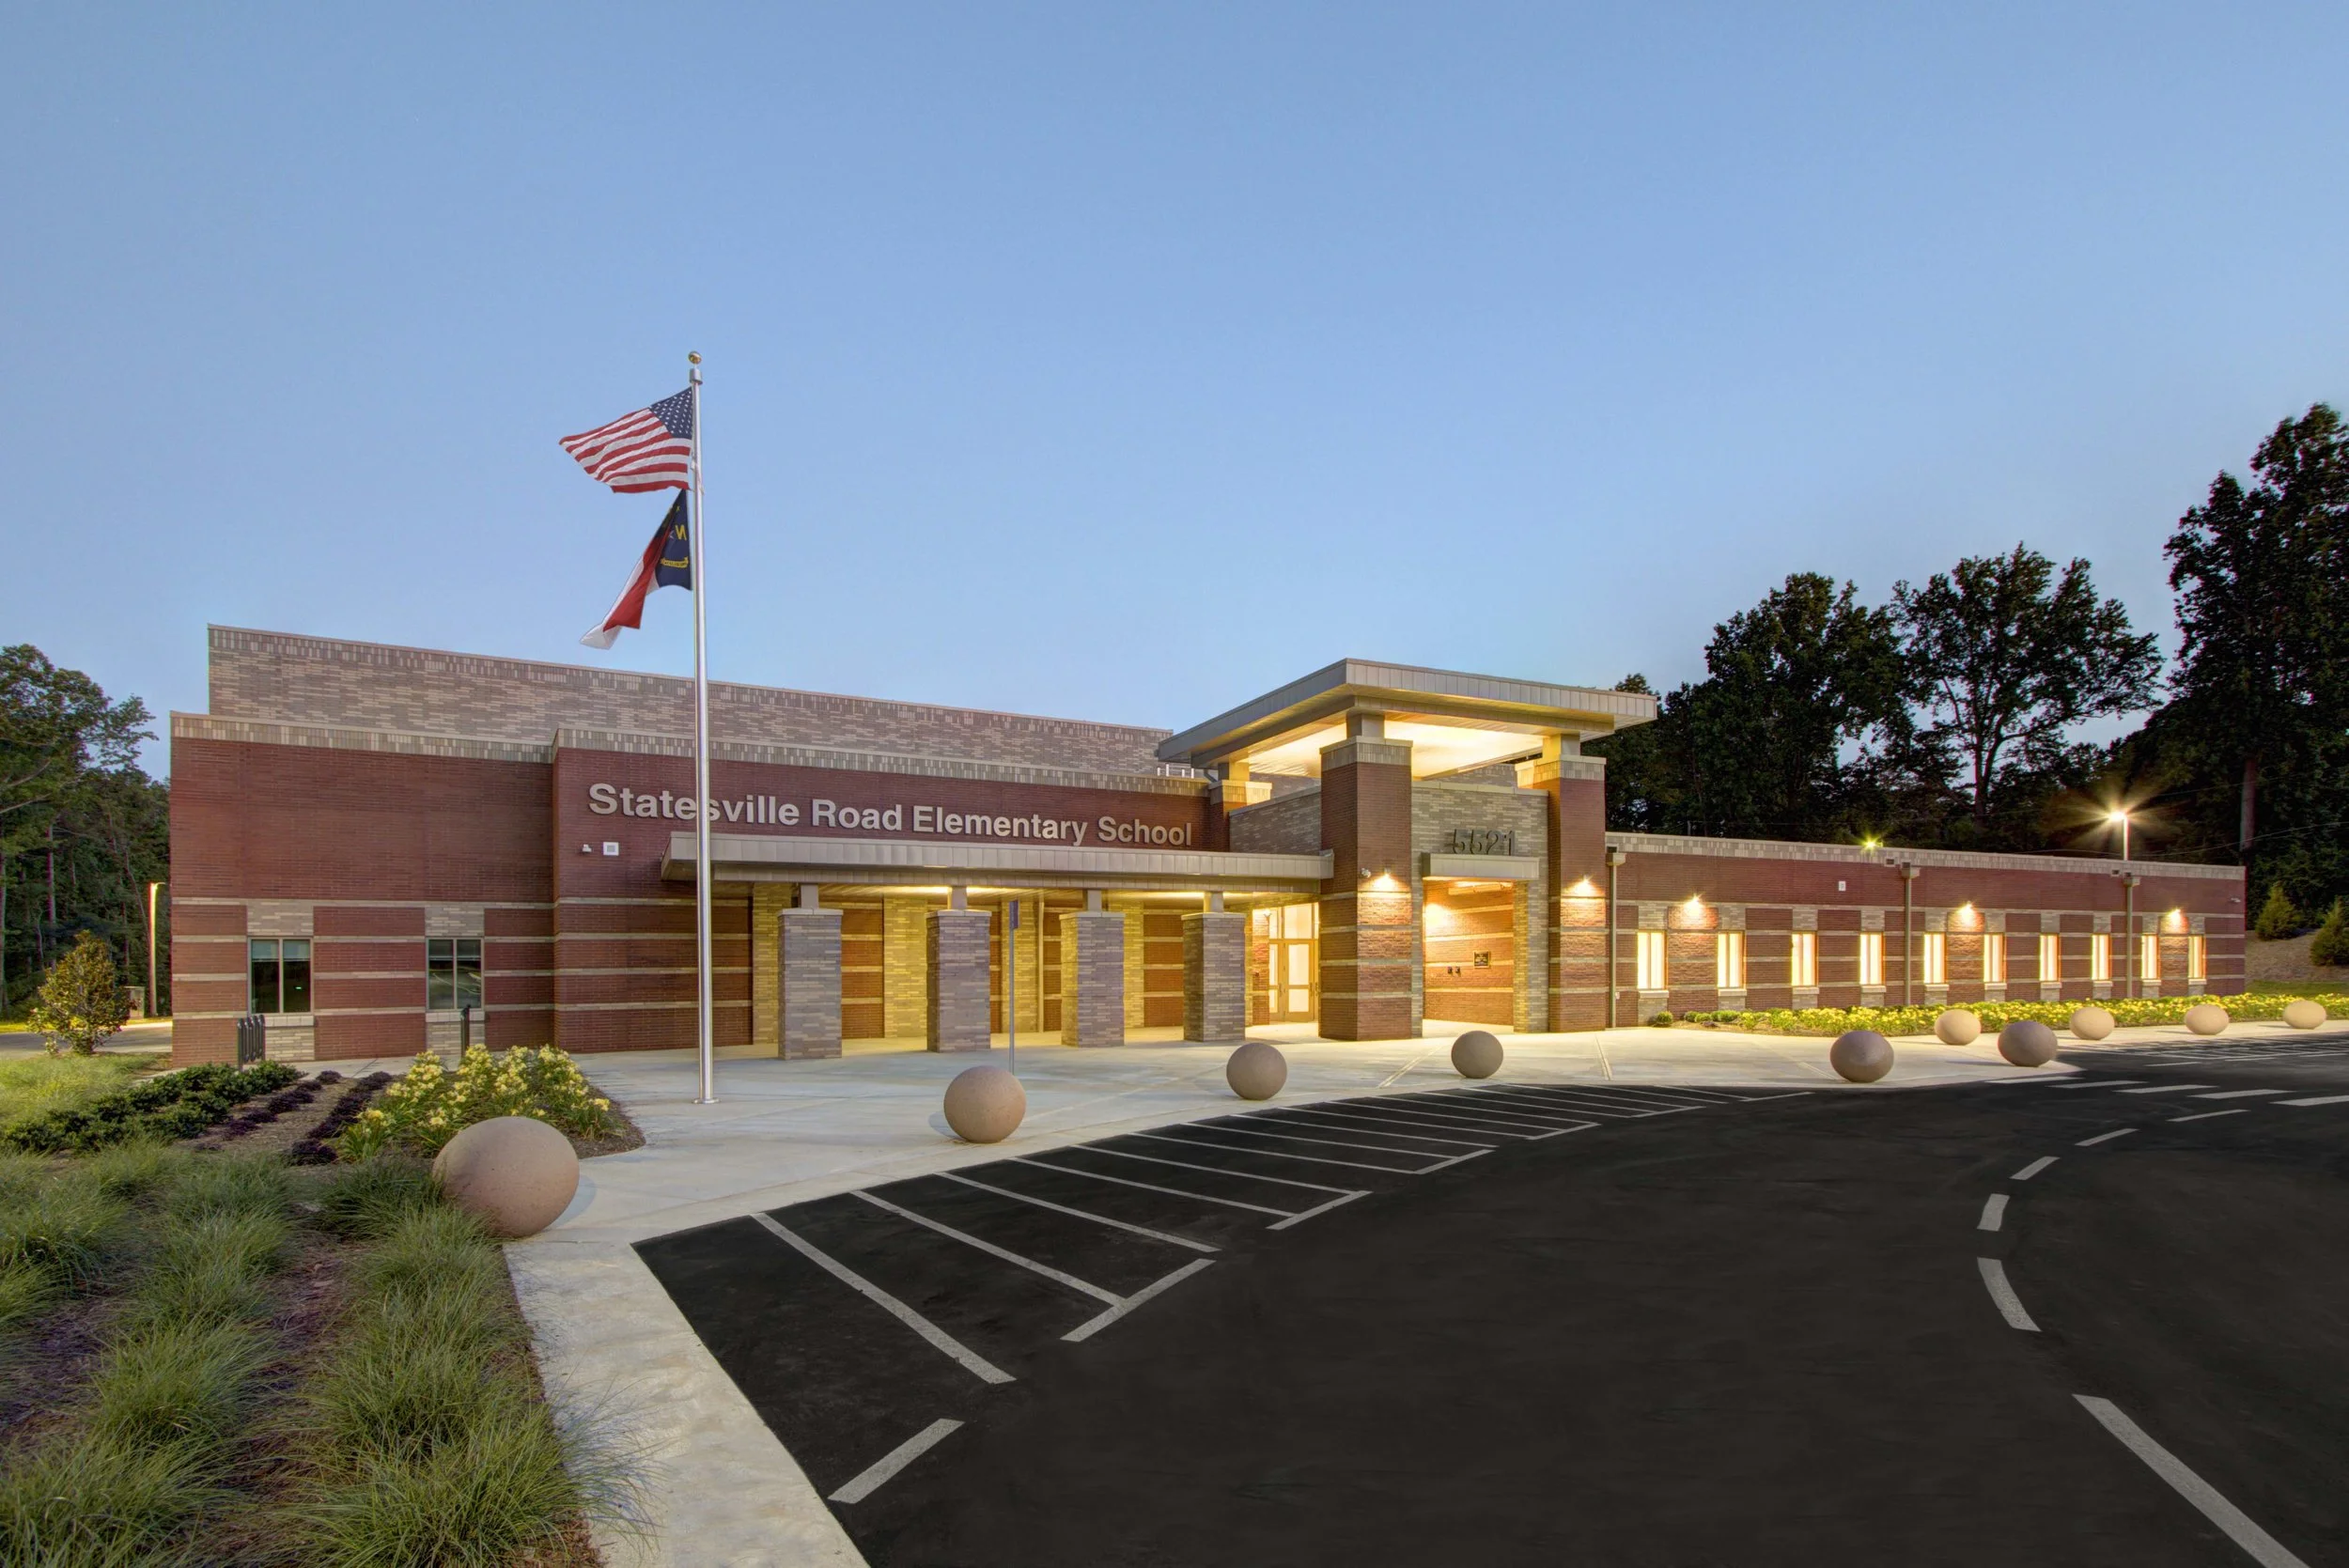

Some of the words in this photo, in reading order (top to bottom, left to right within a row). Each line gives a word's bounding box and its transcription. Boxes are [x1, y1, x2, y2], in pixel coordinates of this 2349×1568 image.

[812, 799, 902, 831] Road
[912, 805, 1088, 846] Elementary
[1097, 815, 1191, 846] School
